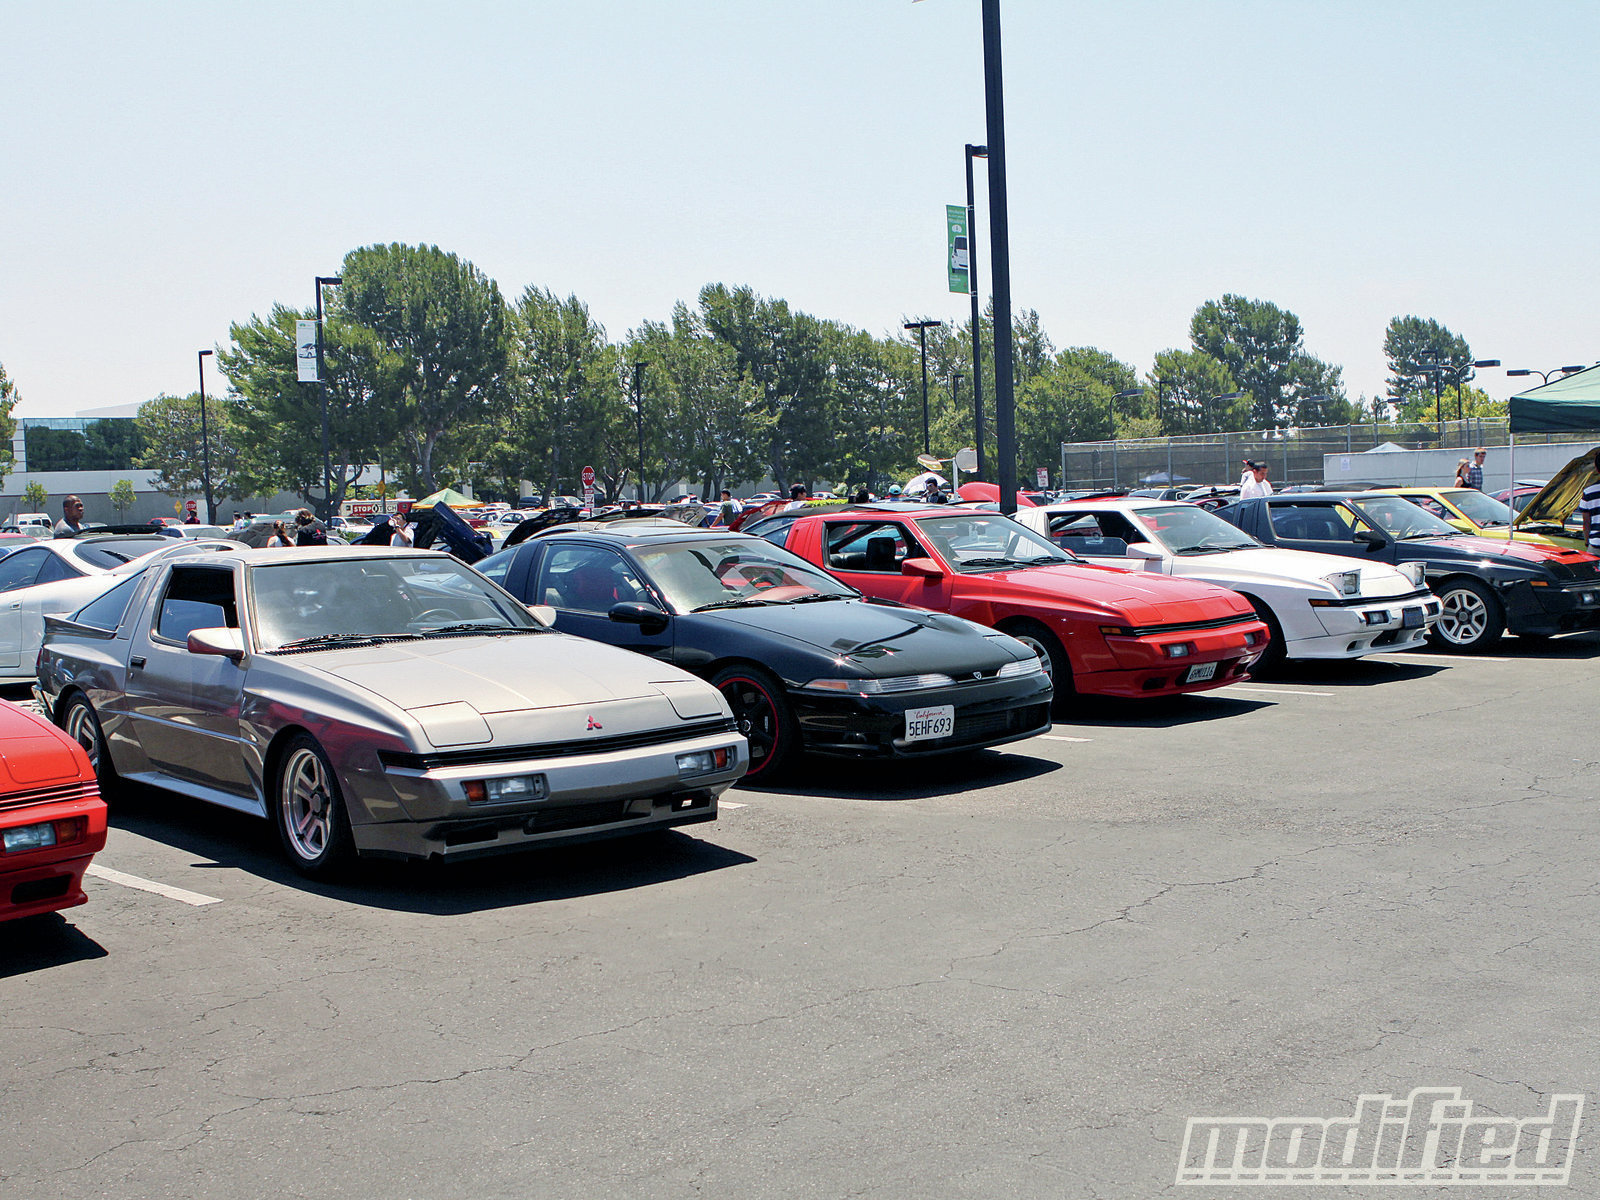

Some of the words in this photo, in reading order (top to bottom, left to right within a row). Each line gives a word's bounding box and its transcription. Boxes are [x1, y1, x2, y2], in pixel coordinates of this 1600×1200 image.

[583, 472, 594, 480] STOP
[378, 505, 397, 513] TCH
[909, 717, 952, 737] 5EHF693
